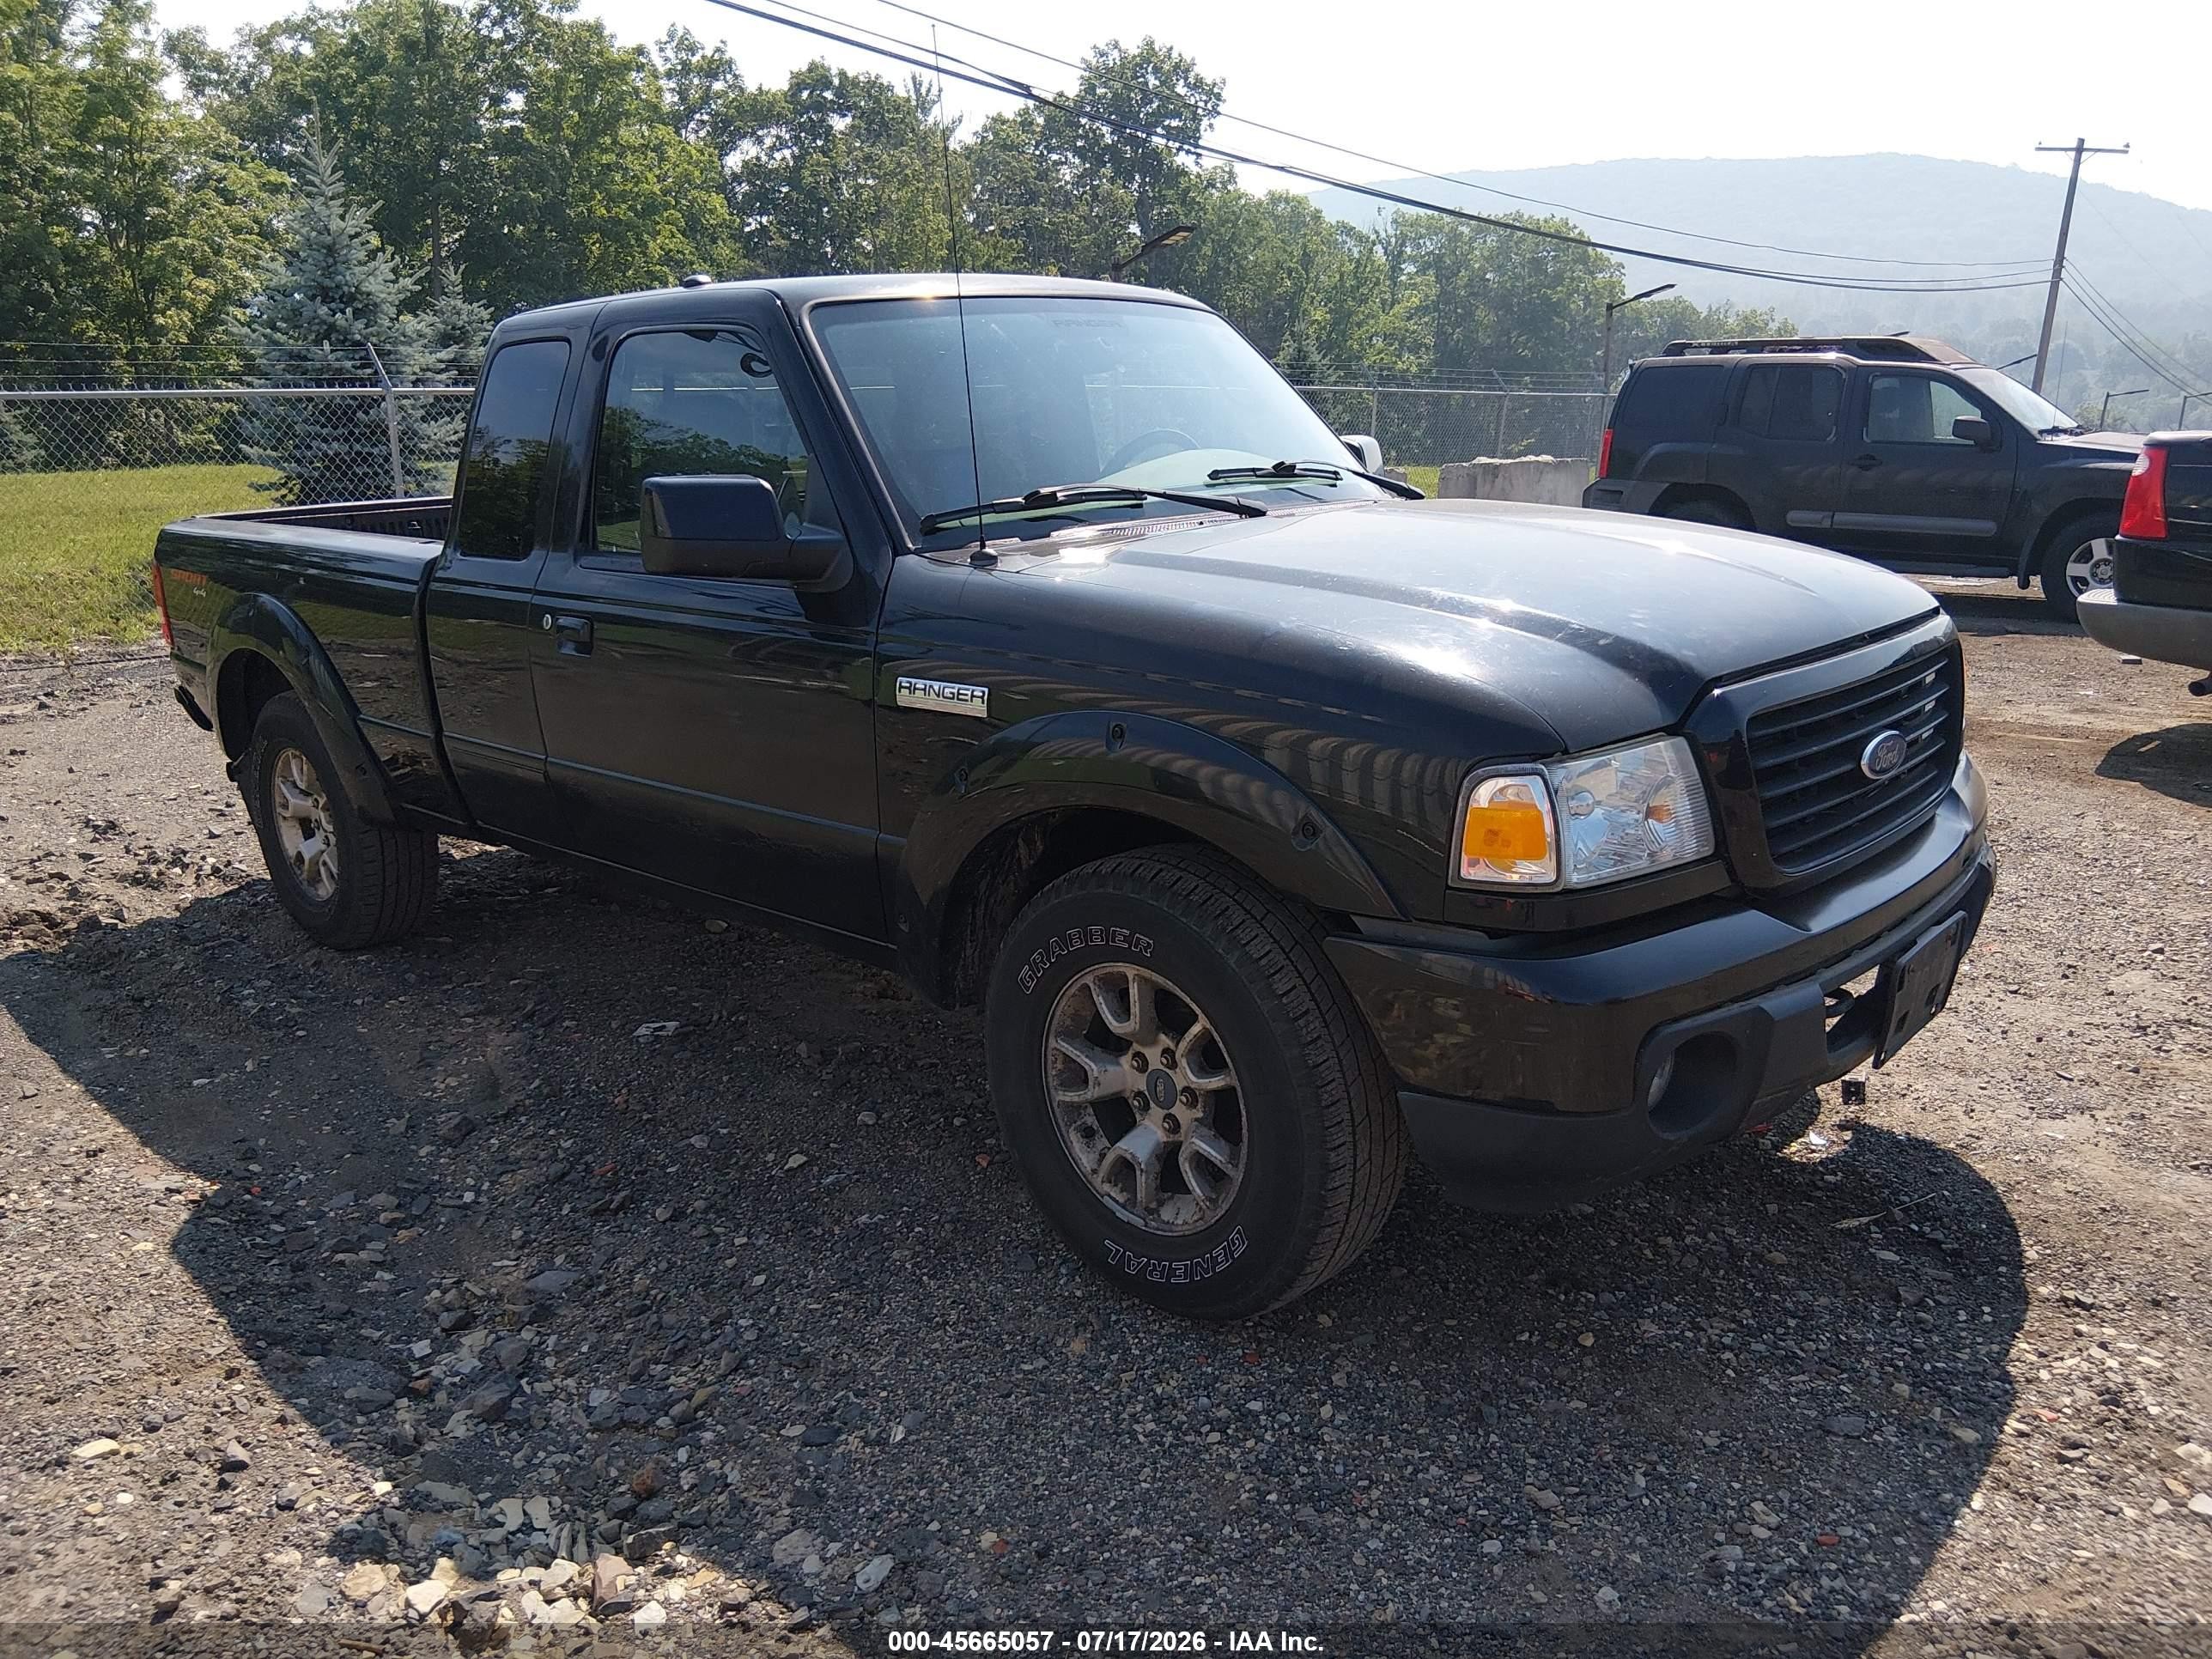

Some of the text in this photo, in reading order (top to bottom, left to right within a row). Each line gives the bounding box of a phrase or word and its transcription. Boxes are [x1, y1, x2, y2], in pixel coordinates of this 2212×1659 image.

[898, 680, 986, 705] RANGER
[1017, 926, 1155, 994] GRABBER
[1104, 1225, 1249, 1284] GENERAL
